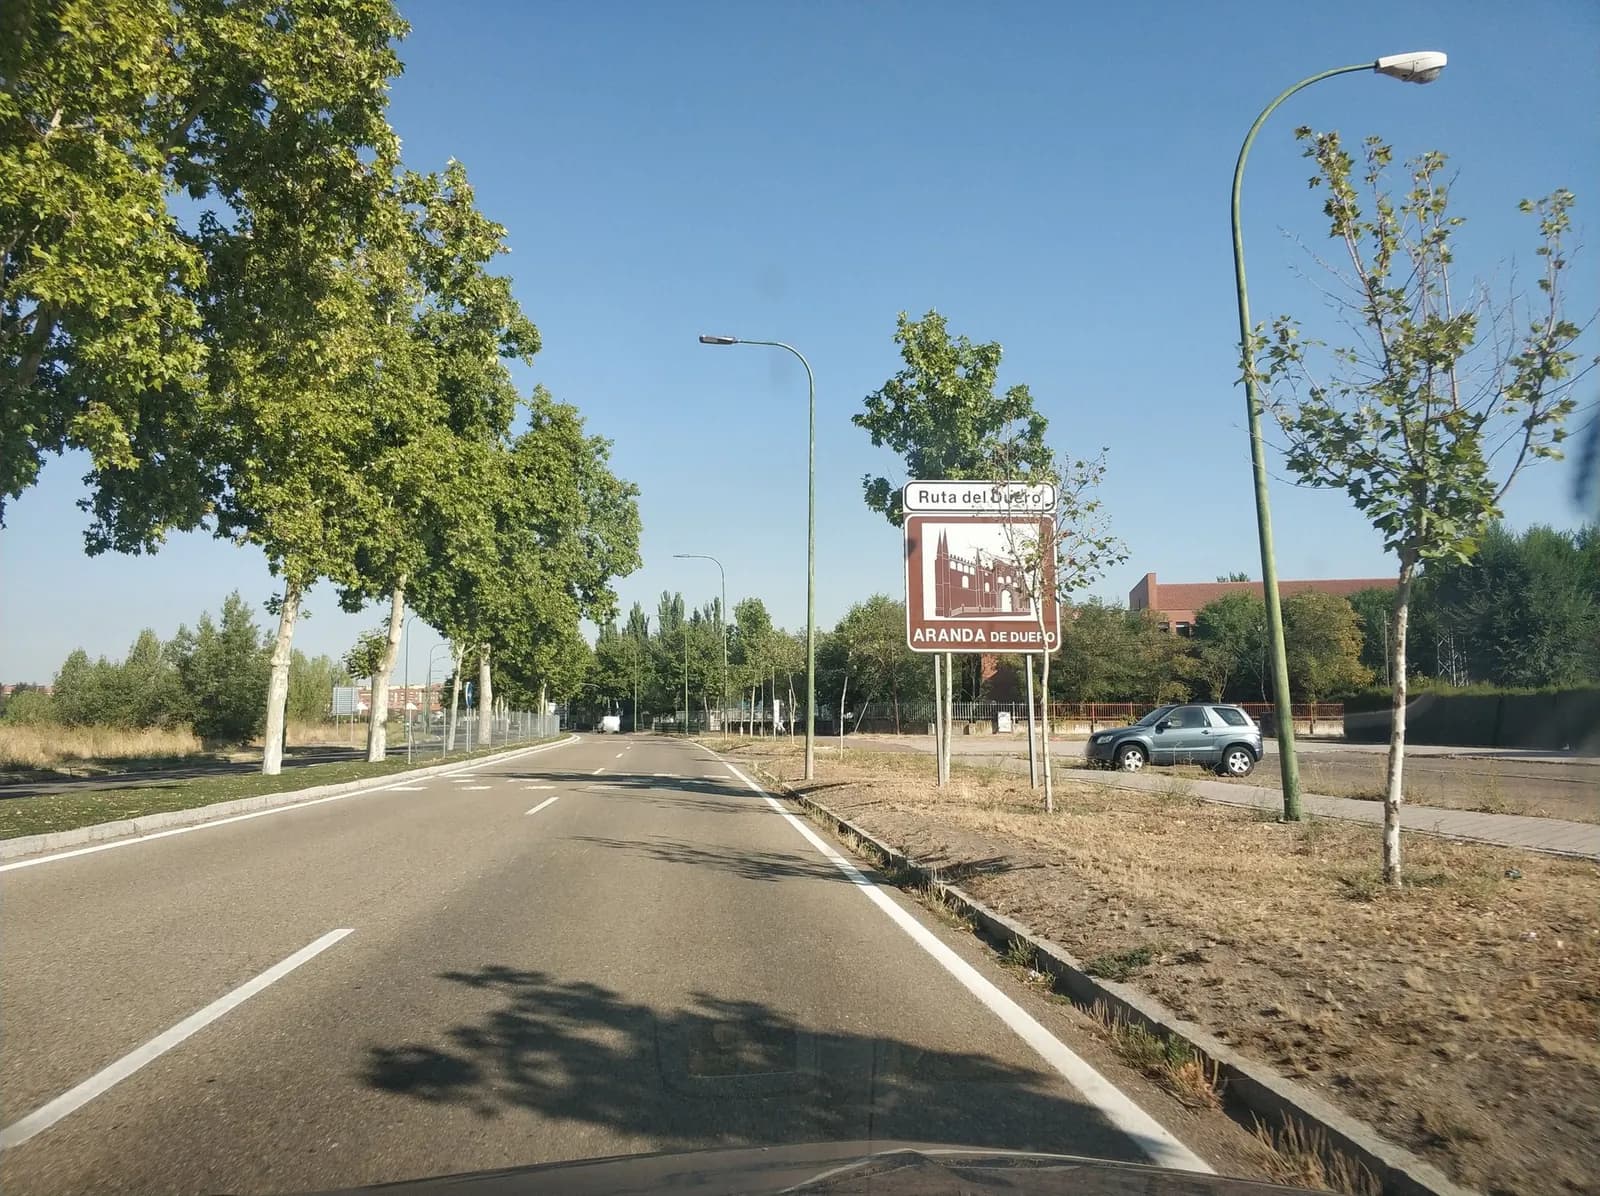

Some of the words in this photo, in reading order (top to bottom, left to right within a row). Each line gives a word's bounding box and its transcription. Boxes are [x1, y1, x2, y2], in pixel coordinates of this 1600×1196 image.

[919, 490, 957, 504] Ruta
[962, 490, 986, 504] del
[991, 490, 1041, 504] Duero
[913, 628, 986, 643] ARANDA
[990, 631, 1007, 643] DE
